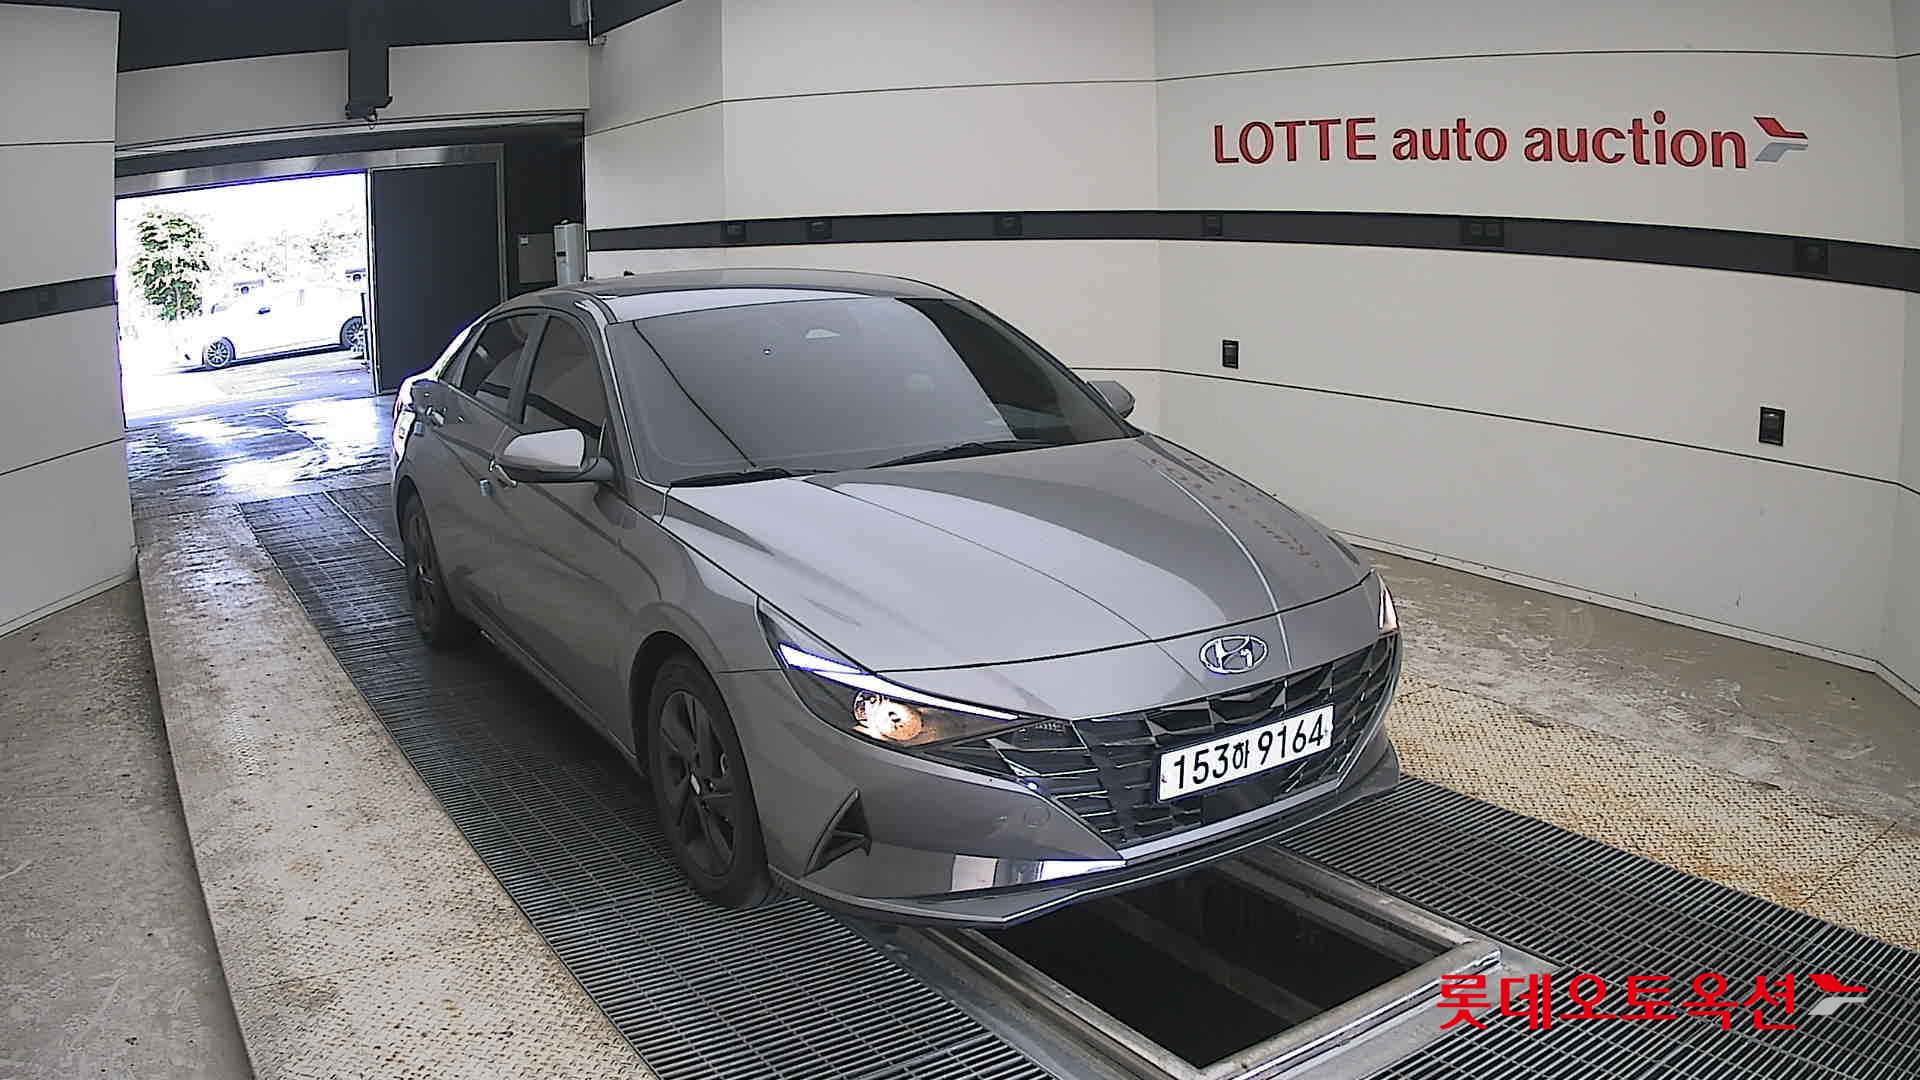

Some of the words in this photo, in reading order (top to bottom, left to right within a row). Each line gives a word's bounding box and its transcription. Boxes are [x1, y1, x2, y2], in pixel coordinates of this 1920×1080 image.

[1213, 116, 1377, 165] LOTTE
[1392, 117, 1508, 162] auto
[1523, 110, 1748, 169] auction
